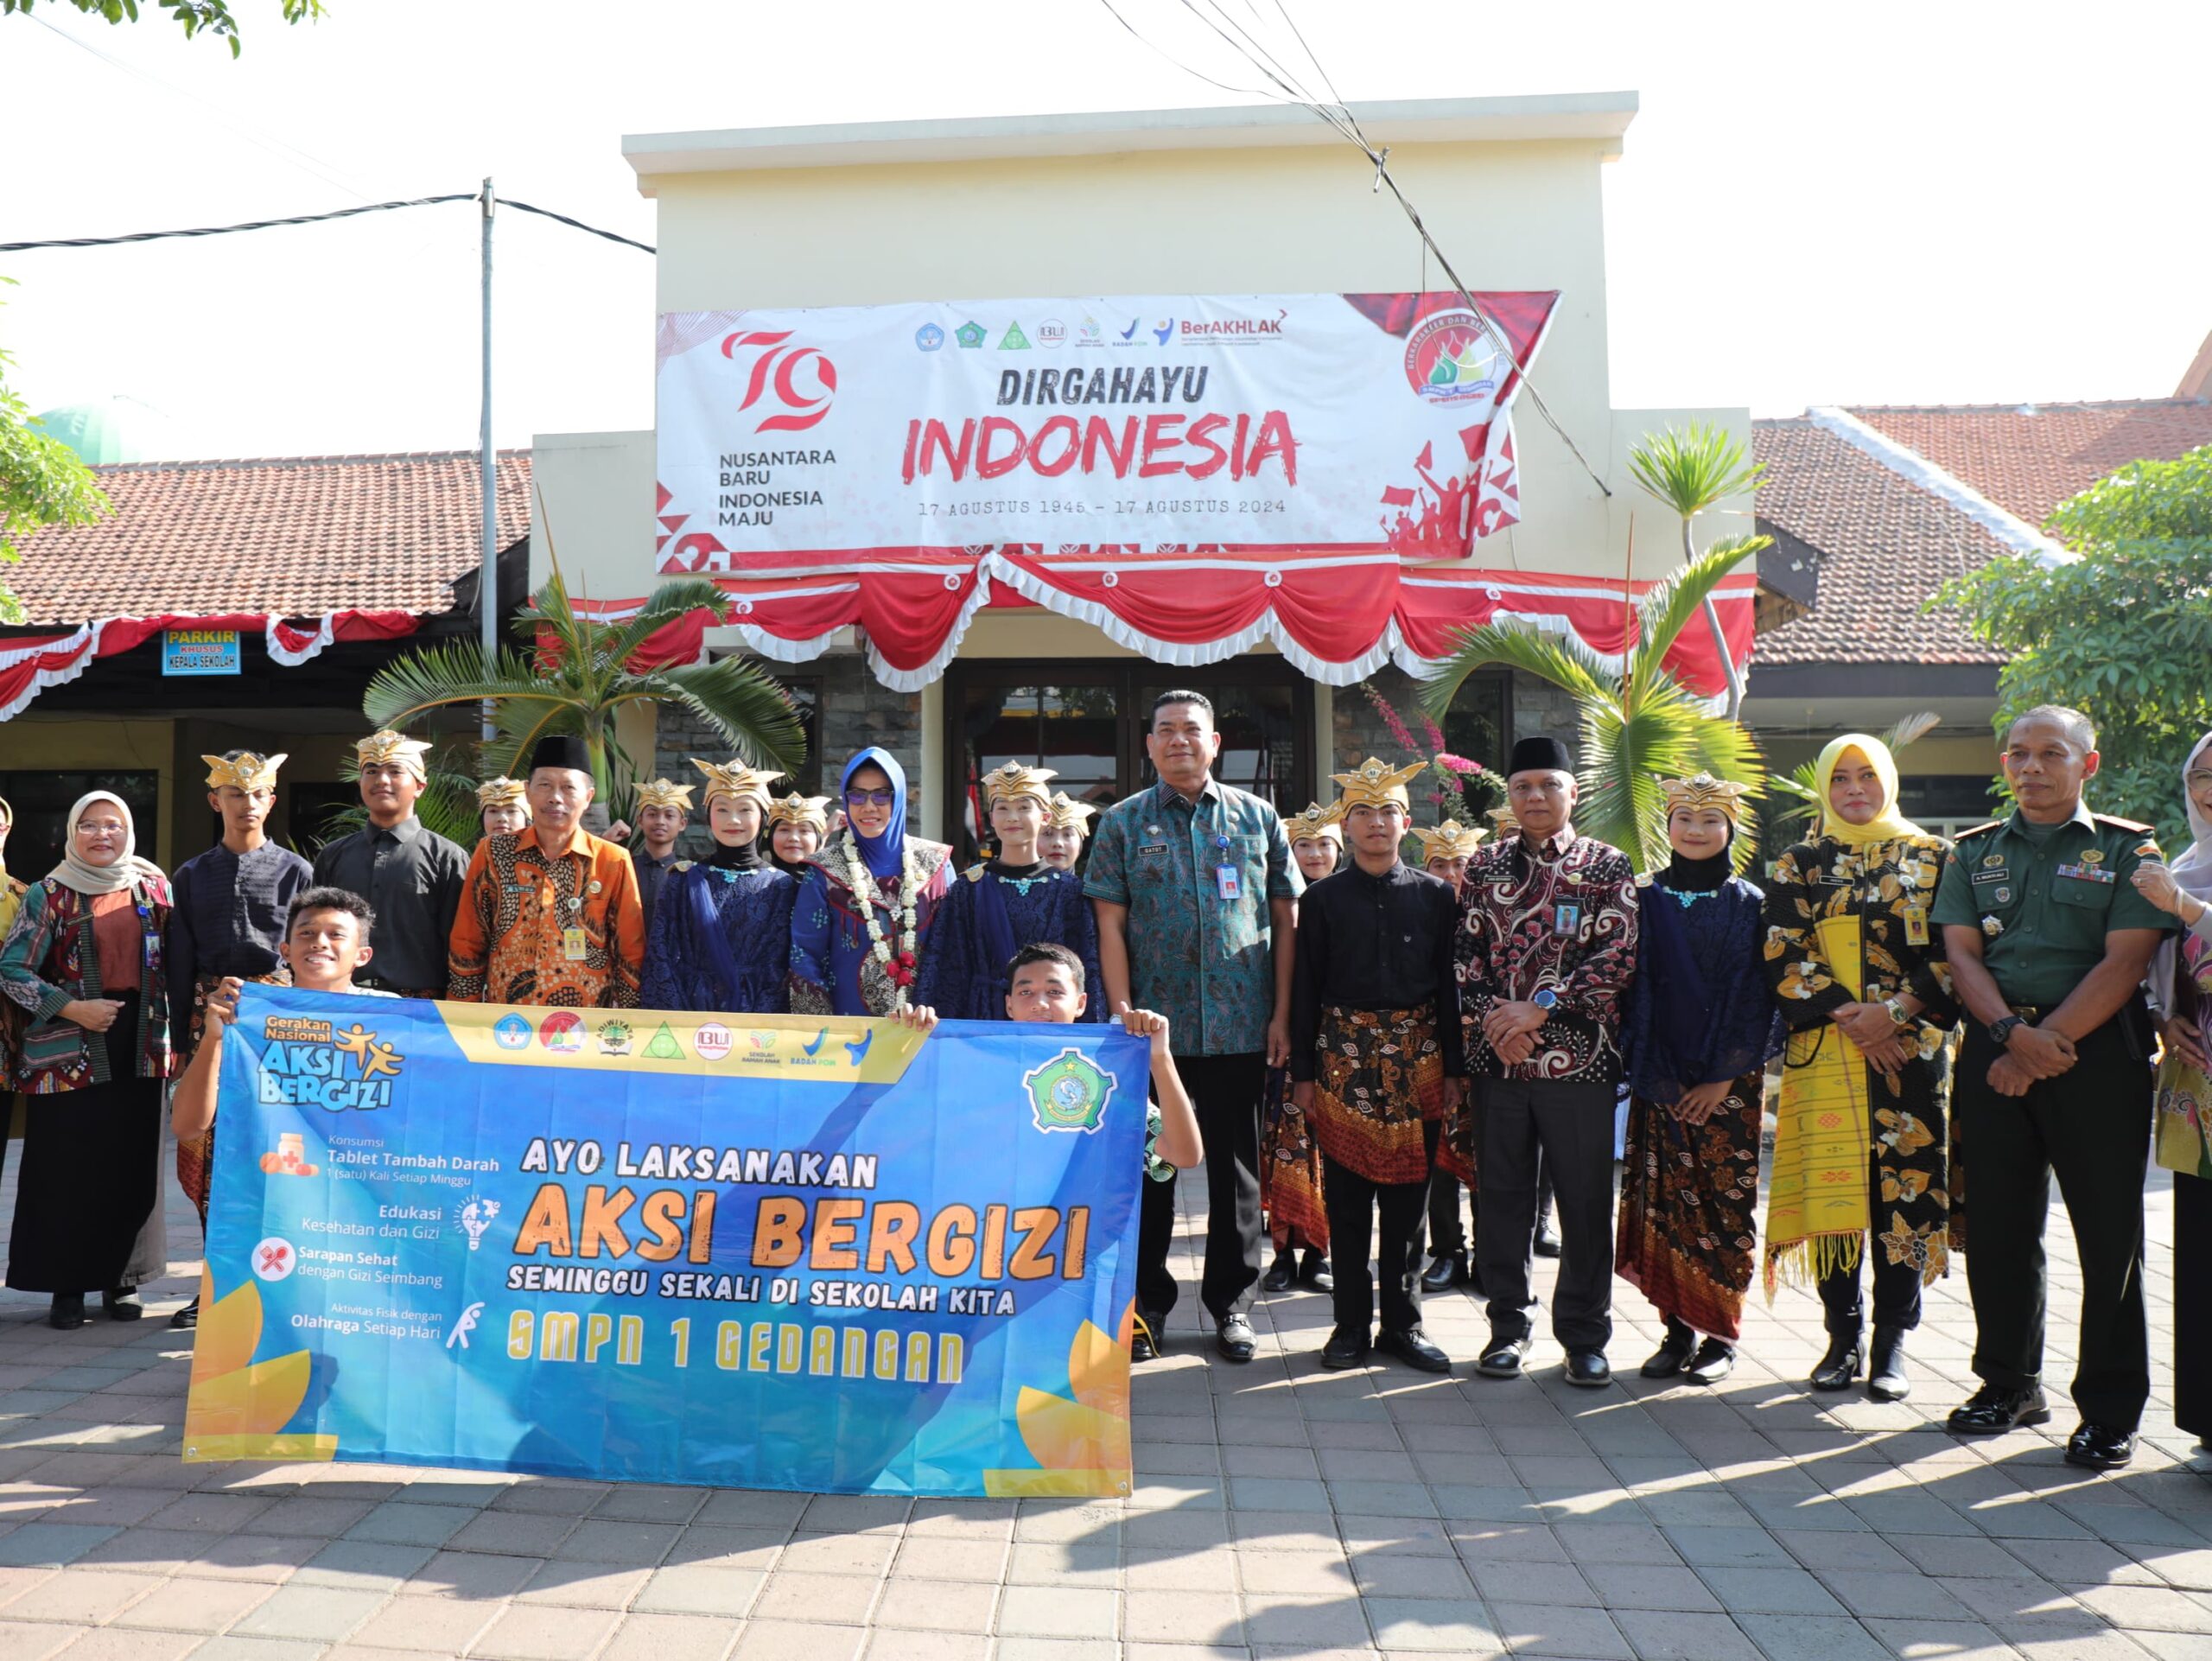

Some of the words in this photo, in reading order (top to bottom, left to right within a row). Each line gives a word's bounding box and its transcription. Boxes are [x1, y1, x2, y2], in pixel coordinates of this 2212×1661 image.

[1180, 319, 1282, 334] BerAKHLAK
[997, 366, 1209, 406] DIRGAHAYU
[901, 410, 1302, 487] INDONESIA
[720, 449, 836, 469] NUSANTARA
[720, 470, 771, 487] BARU
[719, 491, 823, 509] INDONESIA
[918, 502, 940, 517] 17
[949, 500, 1031, 517] AGUSTUS
[1040, 500, 1086, 515] 1945
[1115, 500, 1136, 515] 17
[1146, 500, 1230, 514] AGUSTUS
[1239, 499, 1287, 513] 2024
[719, 511, 773, 527] MAJU
[168, 630, 236, 643] PARKIR
[180, 645, 224, 653] KHUSUS
[169, 655, 197, 668] KEPALA
[200, 655, 235, 668] SEKOLAH
[265, 1015, 332, 1032] Gerakan
[264, 1028, 332, 1044] Nasional
[258, 1041, 346, 1079] AKSI
[259, 1071, 392, 1113] BERGIZI
[328, 1135, 385, 1148] Konsumsi
[327, 1149, 378, 1166] Tablet
[383, 1153, 447, 1168] Tambah
[452, 1156, 499, 1172] Darah
[520, 1137, 602, 1175] AYO
[616, 1142, 879, 1189] LAKSANAKAN
[334, 1168, 367, 1181] (satu)
[370, 1171, 390, 1181] Kali
[392, 1173, 428, 1185] Setiap
[430, 1174, 472, 1188] Minggu
[378, 1205, 442, 1220] Edukasi
[302, 1218, 375, 1237] Kesehatan
[379, 1224, 407, 1238] dan
[412, 1225, 440, 1239] Gizi
[512, 1181, 718, 1264] AKSI
[750, 1195, 1090, 1282] BERGIZI
[299, 1246, 353, 1264] Sarapan
[357, 1251, 398, 1266] Sehat
[297, 1263, 345, 1280] dengan
[348, 1268, 372, 1282] Gizi
[375, 1270, 443, 1289] Seimbang
[506, 1264, 649, 1296] SEMINGGU
[659, 1272, 761, 1303] SEKALI
[770, 1278, 799, 1305] DI
[809, 1280, 939, 1313] SEKOLAH
[949, 1286, 1016, 1316] KITA
[331, 1303, 374, 1316] Aktivitas
[376, 1307, 398, 1319] Fisik
[401, 1309, 442, 1323] dengan
[291, 1314, 359, 1334] Olahraga
[363, 1321, 406, 1340] Setiap
[410, 1325, 441, 1339] Hari
[507, 1308, 644, 1365] SMPN
[671, 1317, 690, 1368] 1
[715, 1320, 964, 1384] GEDANGAN
